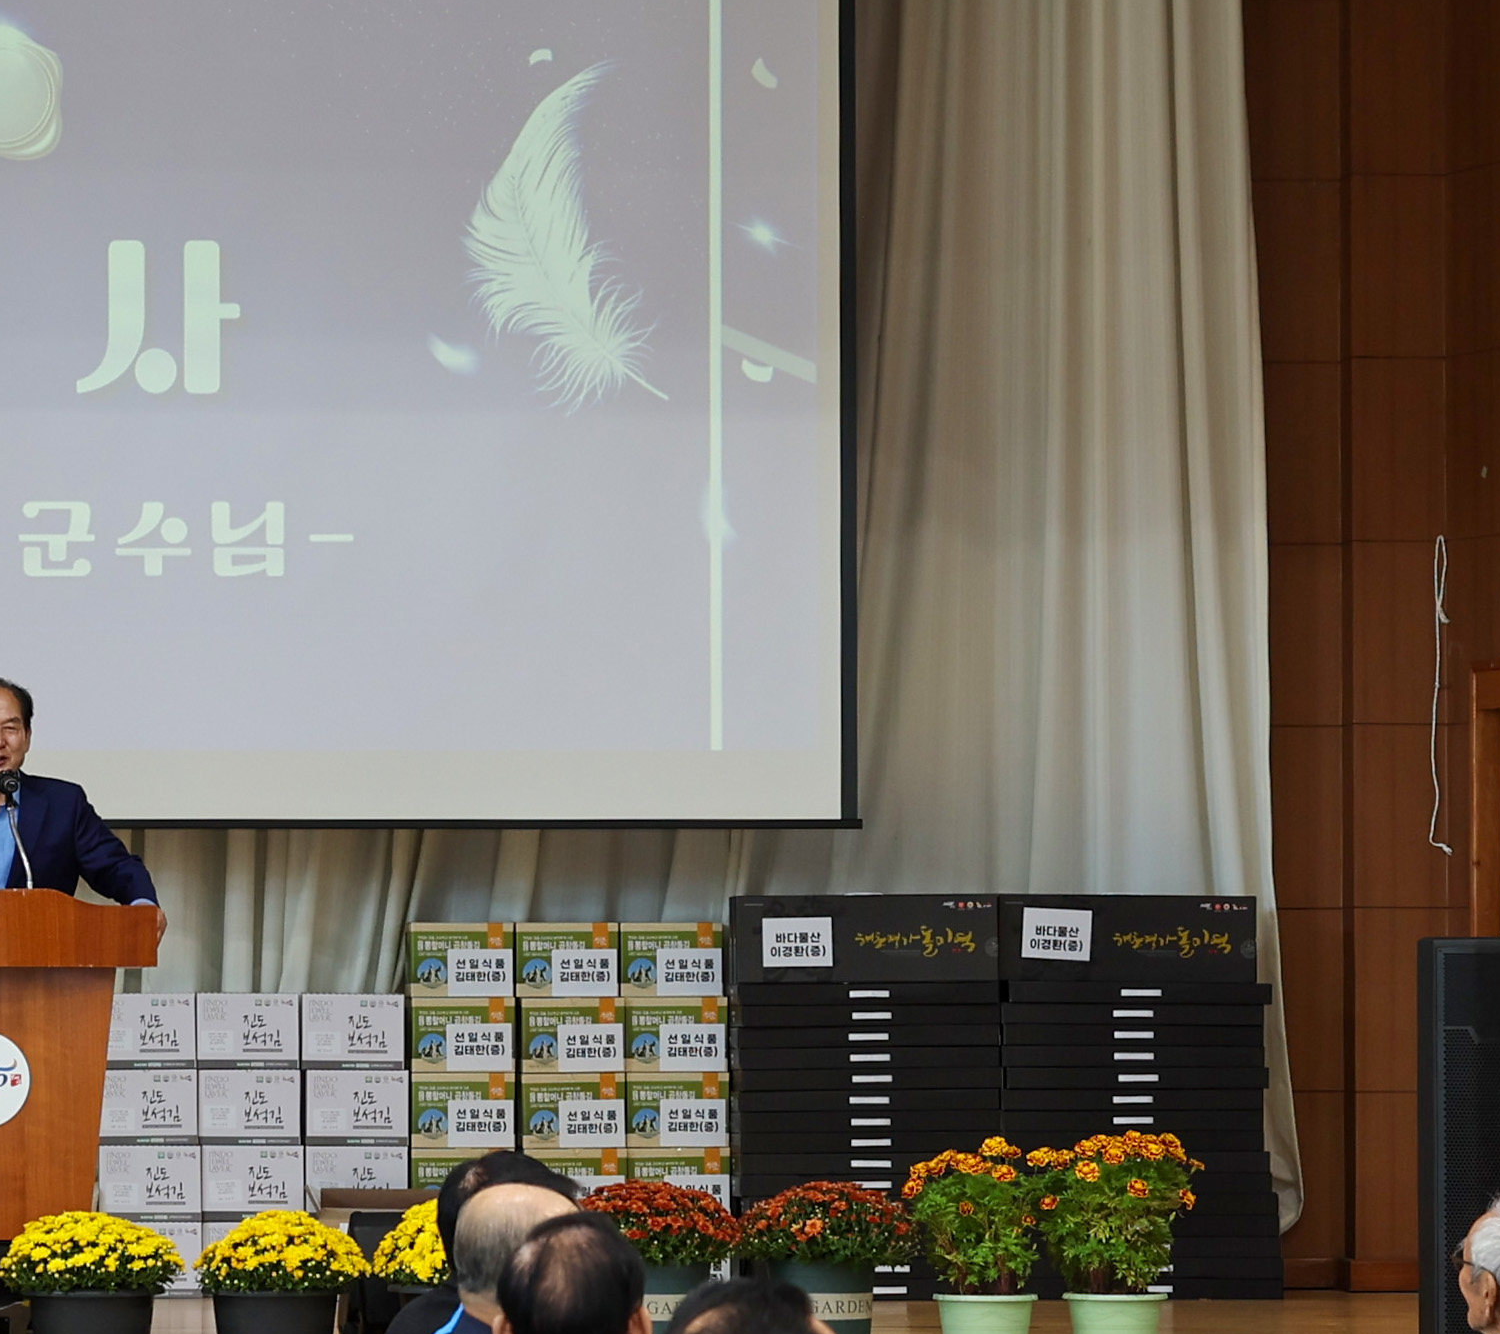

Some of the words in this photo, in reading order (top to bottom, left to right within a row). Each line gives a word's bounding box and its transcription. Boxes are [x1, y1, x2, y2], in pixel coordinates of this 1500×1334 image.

[76, 238, 241, 397] 사
[18, 499, 354, 580] 군수님-
[775, 932, 821, 943] 바다물산
[1035, 925, 1080, 937] 바다물산
[140, 1014, 164, 1028] 진도
[243, 1014, 267, 1028] 진도
[348, 1015, 373, 1029] 진도
[140, 1030, 180, 1047] 보석김
[243, 1029, 283, 1047] 보석김
[348, 1031, 388, 1048] 보석김
[142, 1090, 166, 1104] 진도
[245, 1090, 269, 1104] 진도
[353, 1090, 377, 1104] 진도
[142, 1105, 182, 1124] 보석김
[244, 1106, 284, 1124] 보석김
[353, 1106, 393, 1124] 보석김
[146, 1166, 170, 1181] 진도
[249, 1165, 273, 1180] 진도
[353, 1166, 377, 1181] 진도
[146, 1182, 186, 1200] 보석김
[248, 1181, 288, 1199] 보석김
